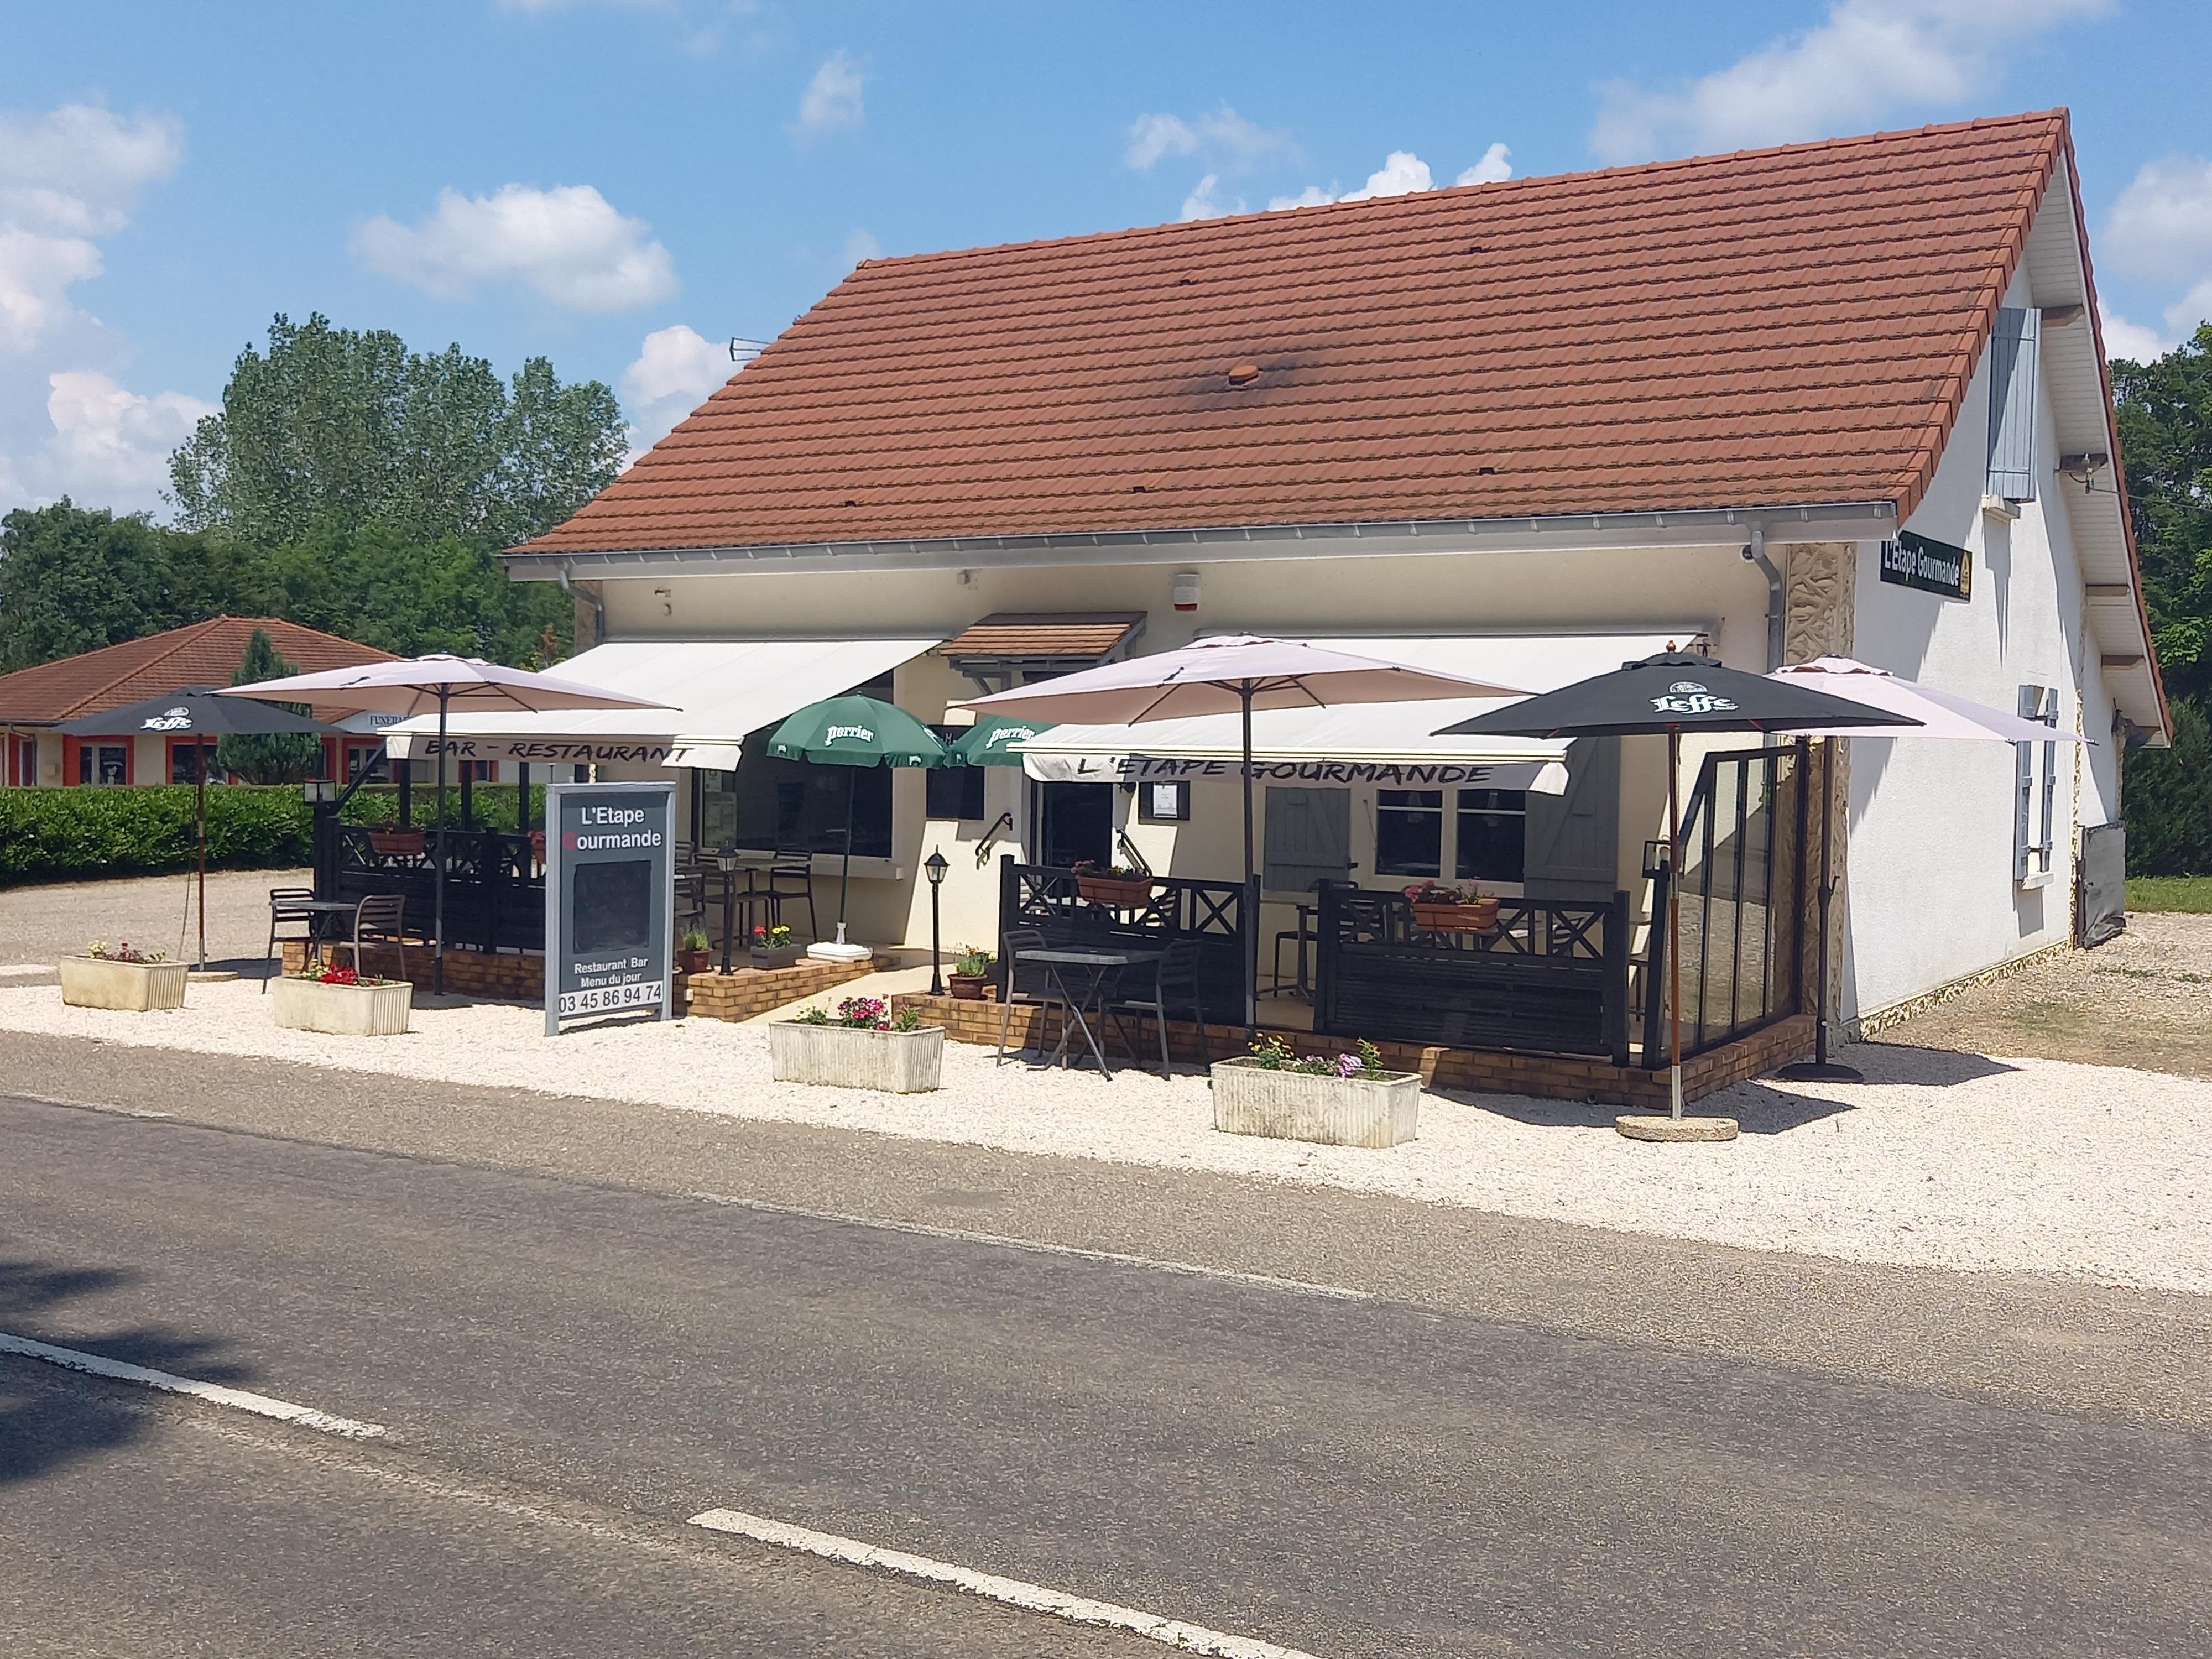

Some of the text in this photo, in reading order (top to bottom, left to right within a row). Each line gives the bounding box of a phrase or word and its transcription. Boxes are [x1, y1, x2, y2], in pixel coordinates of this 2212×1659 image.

[1918, 546, 1959, 586] Gourmande
[1650, 694, 1735, 714] Leffe
[825, 724, 874, 747] perrier
[425, 740, 476, 757] BAR
[508, 743, 695, 762] RESTAURANT
[1078, 757, 1494, 785] L'ETAPE GOURMANDE
[582, 807, 645, 828] L'Etape
[564, 829, 662, 851] Gourmande
[575, 957, 648, 974] Restaurant Bar
[581, 973, 641, 988] Menu du jour
[559, 984, 661, 1013] 03 45 86 94 74
